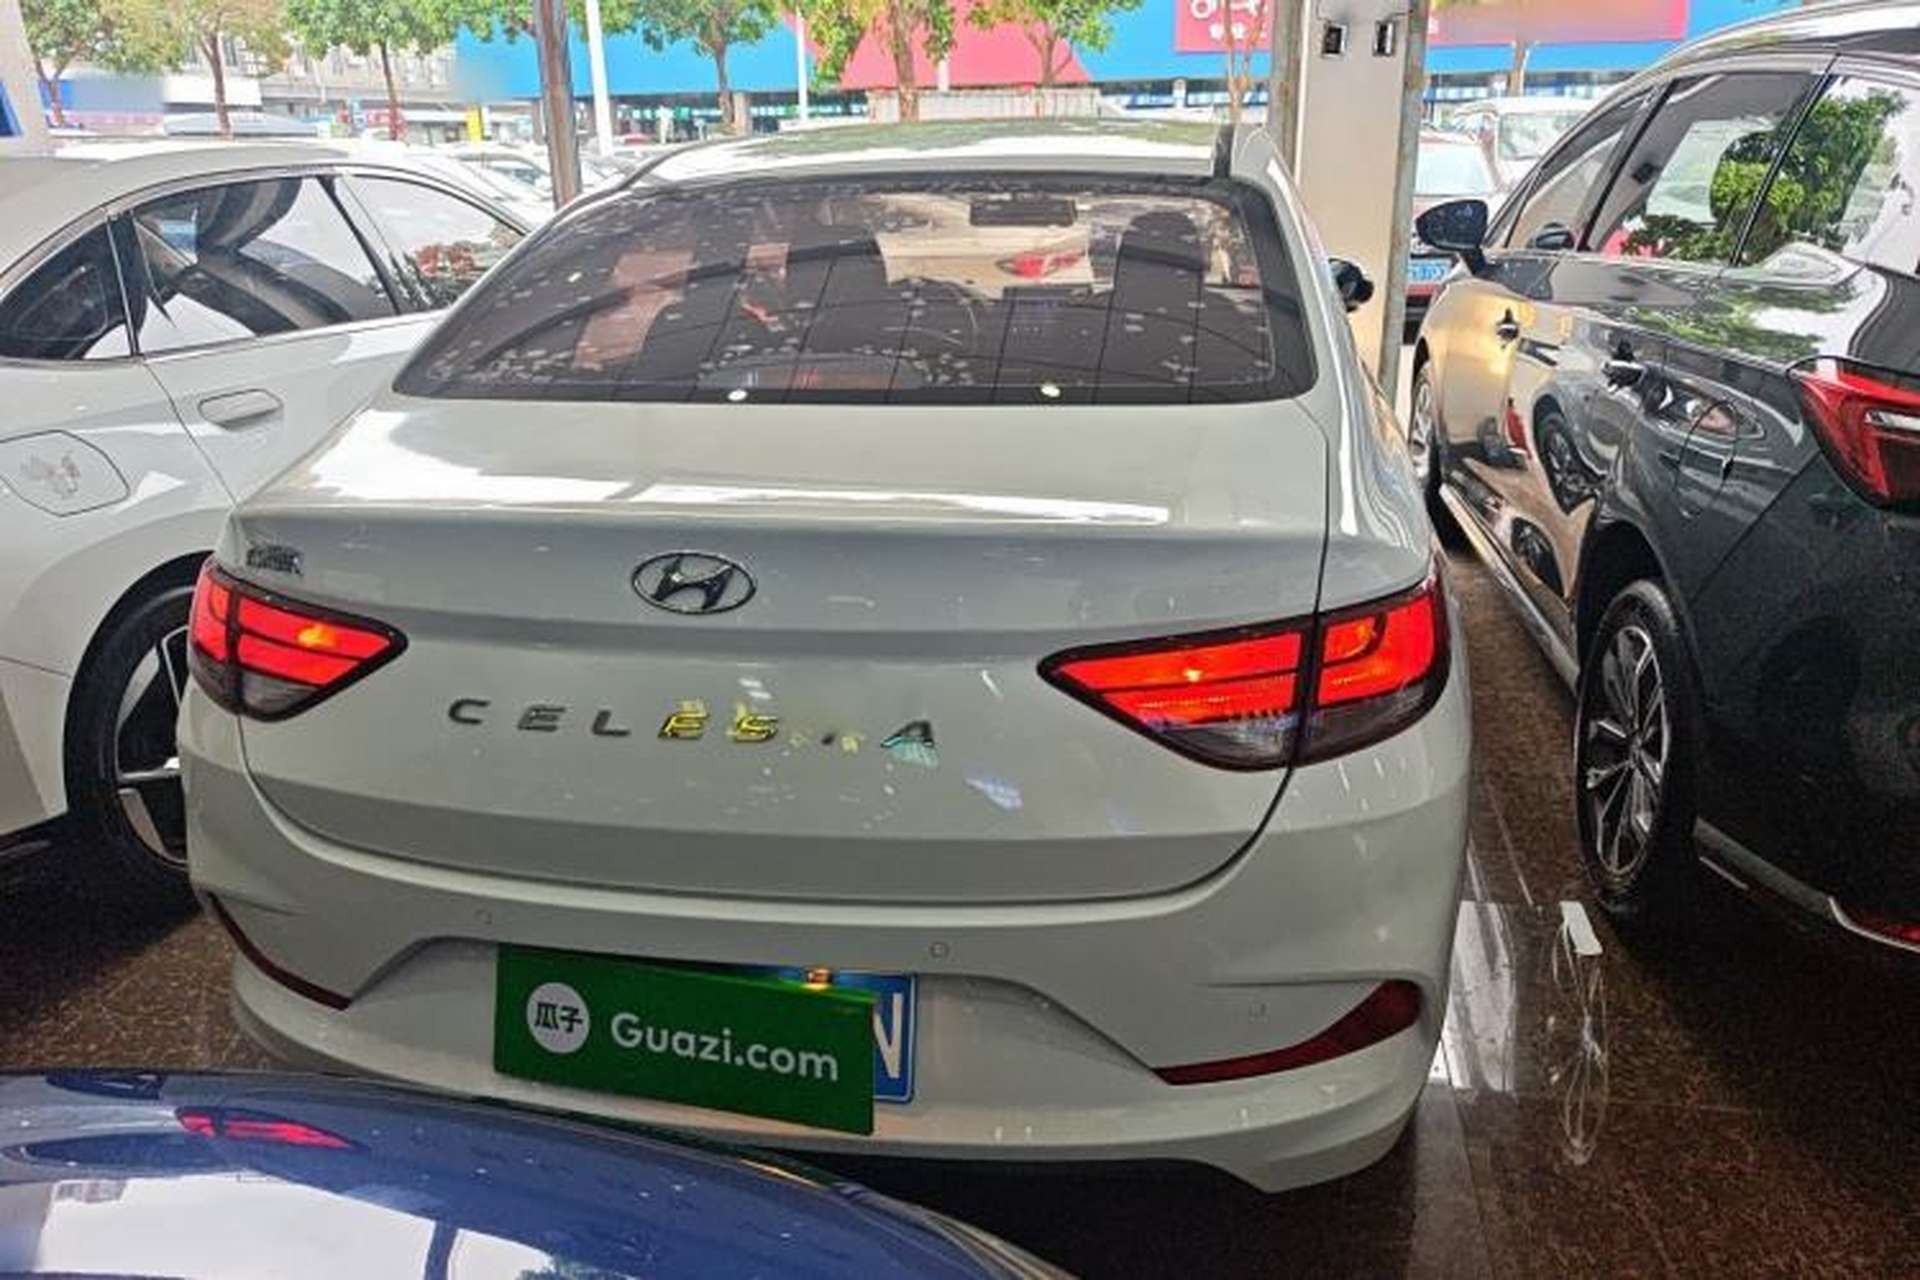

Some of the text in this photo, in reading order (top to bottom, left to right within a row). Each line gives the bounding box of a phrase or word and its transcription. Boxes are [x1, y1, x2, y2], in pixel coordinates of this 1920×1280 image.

[447, 698, 936, 750] CELESA
[534, 1001, 584, 1034] 瓜子
[610, 1012, 839, 1082] Guazi.com
